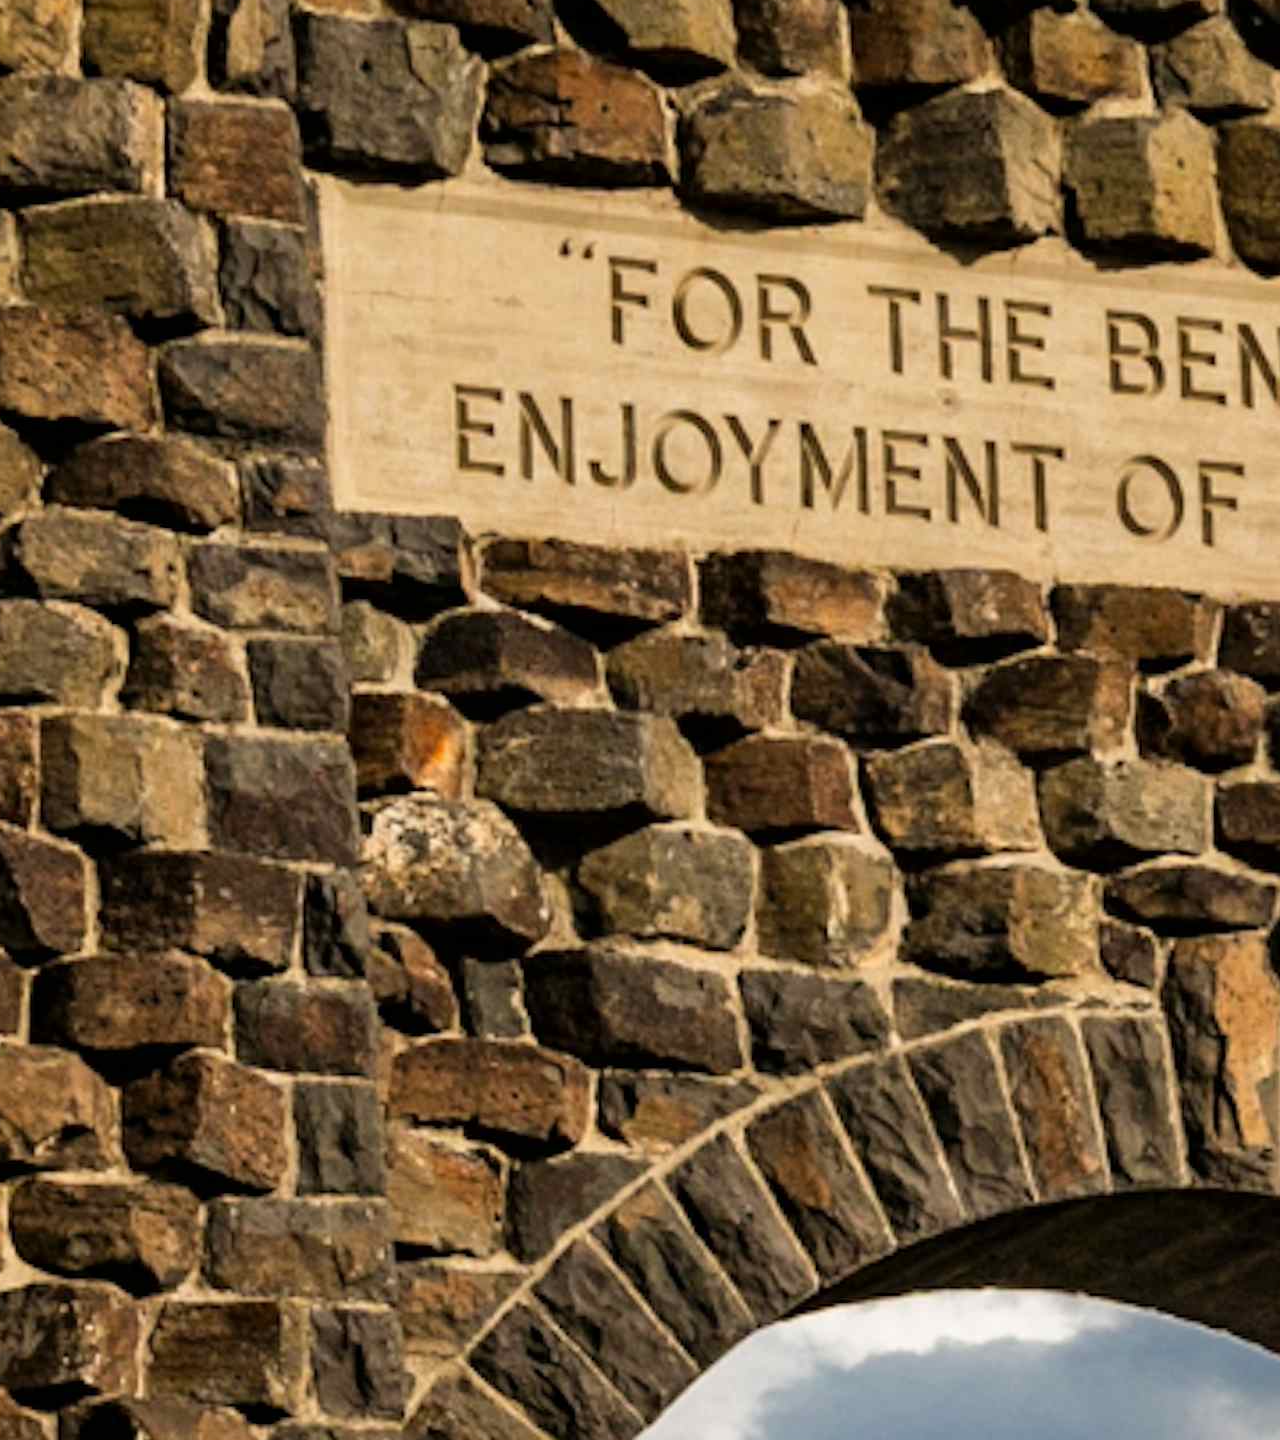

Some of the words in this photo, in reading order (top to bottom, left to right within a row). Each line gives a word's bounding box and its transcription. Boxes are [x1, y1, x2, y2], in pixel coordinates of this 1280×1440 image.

[866, 283, 1056, 390] THE
[454, 382, 1067, 532] ENJOYMENT
[1117, 454, 1245, 550] OF
